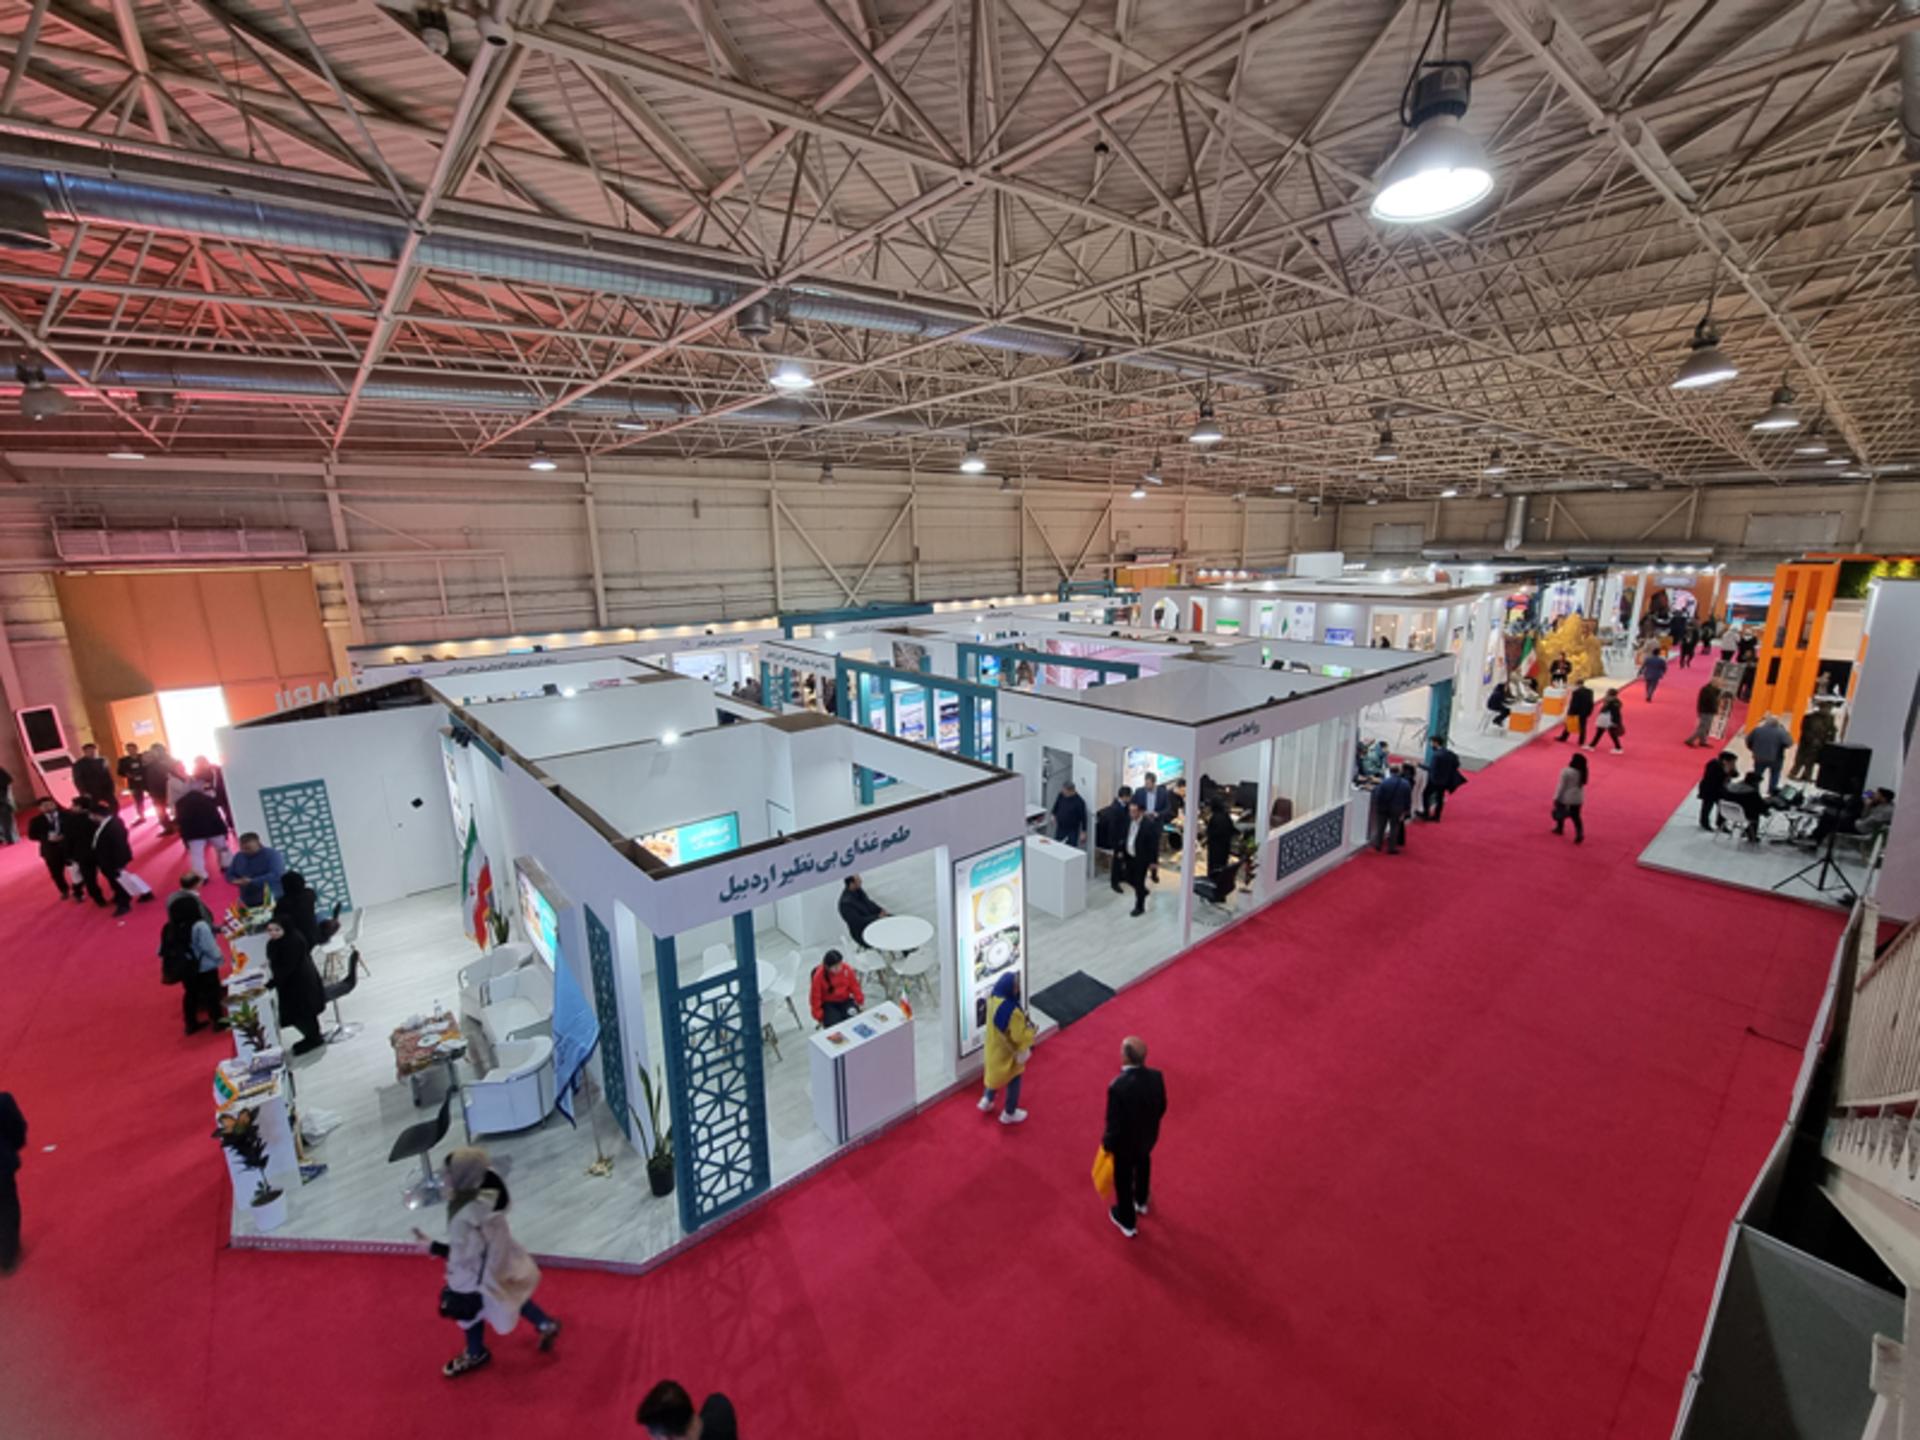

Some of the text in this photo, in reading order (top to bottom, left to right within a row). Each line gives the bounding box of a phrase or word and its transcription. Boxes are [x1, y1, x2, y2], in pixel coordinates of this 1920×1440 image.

[718, 825, 911, 902] طعم غذای بی نظیر اردبیل
